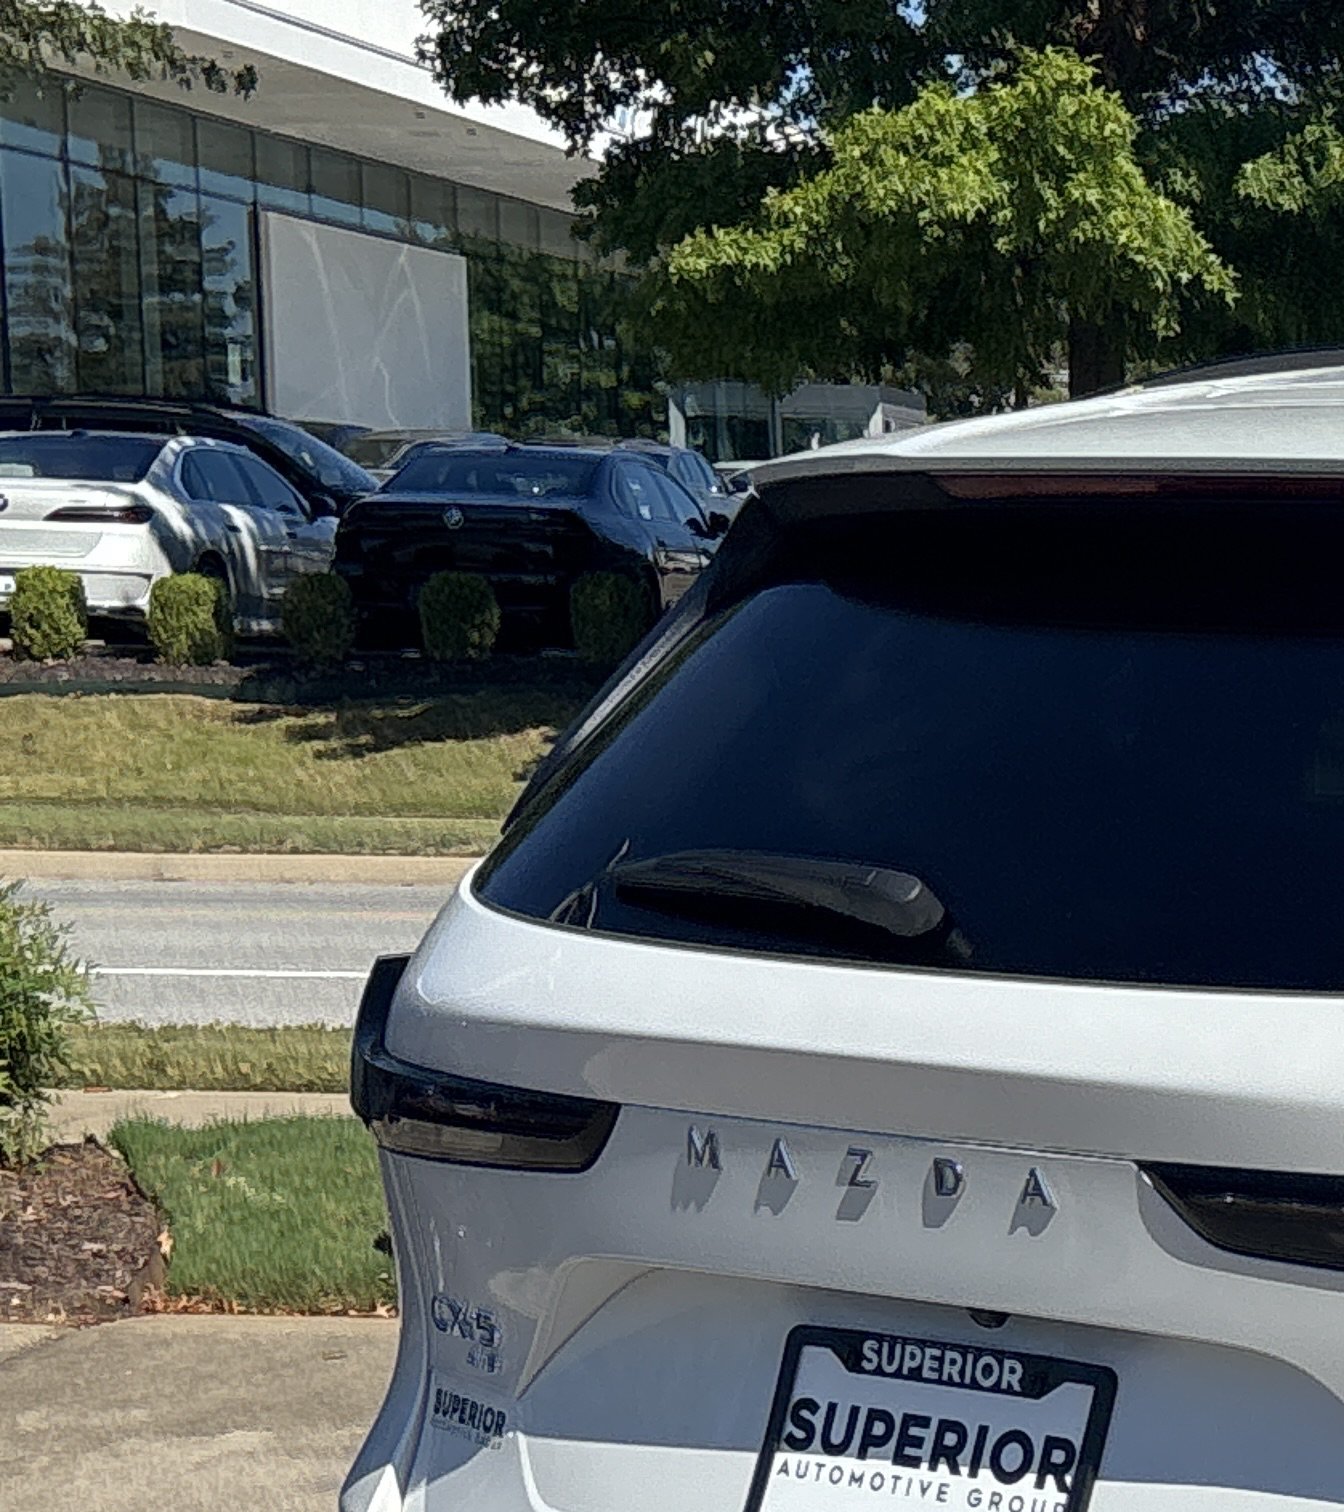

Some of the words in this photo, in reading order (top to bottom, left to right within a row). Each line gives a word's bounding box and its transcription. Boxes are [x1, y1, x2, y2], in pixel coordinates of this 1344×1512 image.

[686, 1125, 1058, 1208] MAZDA
[861, 1339, 1023, 1392] SUPERIOR
[434, 1388, 506, 1437] SUPERIOR
[783, 1397, 1077, 1496] SUPERIOR
[776, 1458, 950, 1503] AUTOMOTIVE
